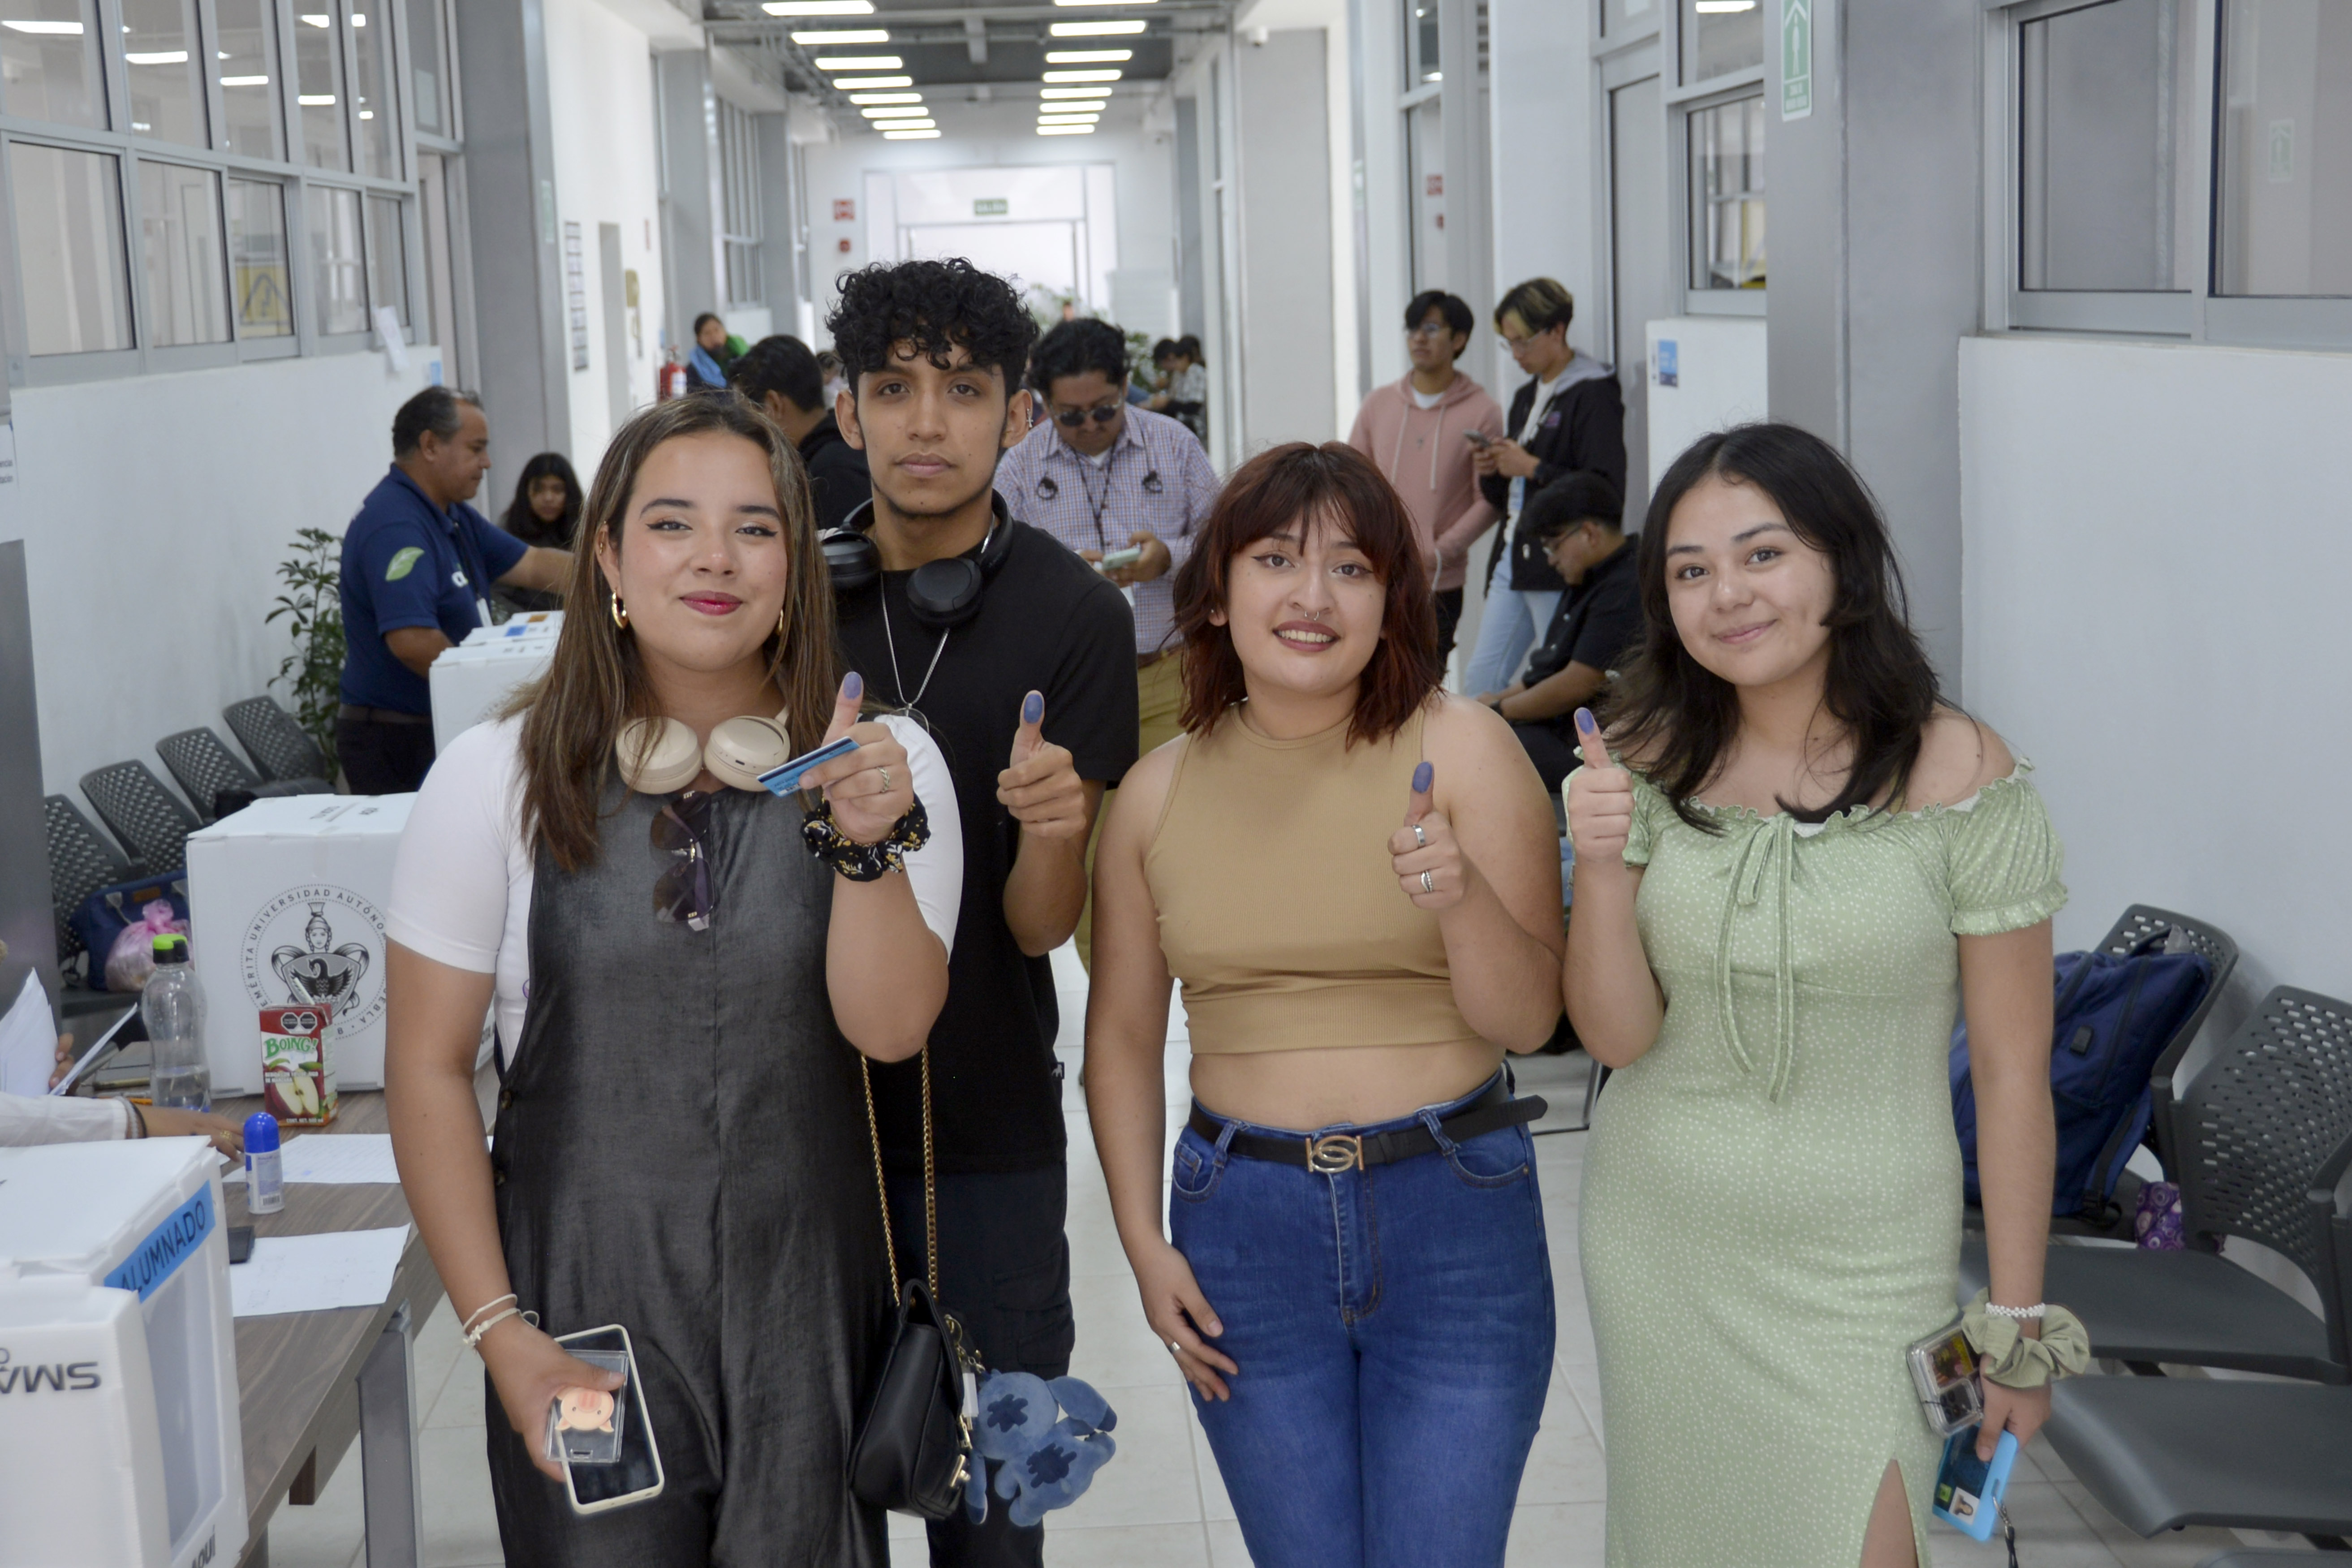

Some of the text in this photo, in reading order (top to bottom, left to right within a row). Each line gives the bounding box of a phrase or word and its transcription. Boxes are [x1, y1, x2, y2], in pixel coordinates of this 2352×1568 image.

[249, 888, 331, 940] UNIVERSIDAD
[337, 893, 387, 940] AUTÓNO
[359, 988, 387, 1023] EBLA
[265, 1037, 319, 1059] BOING!
[121, 1200, 206, 1293] ALUMNADO
